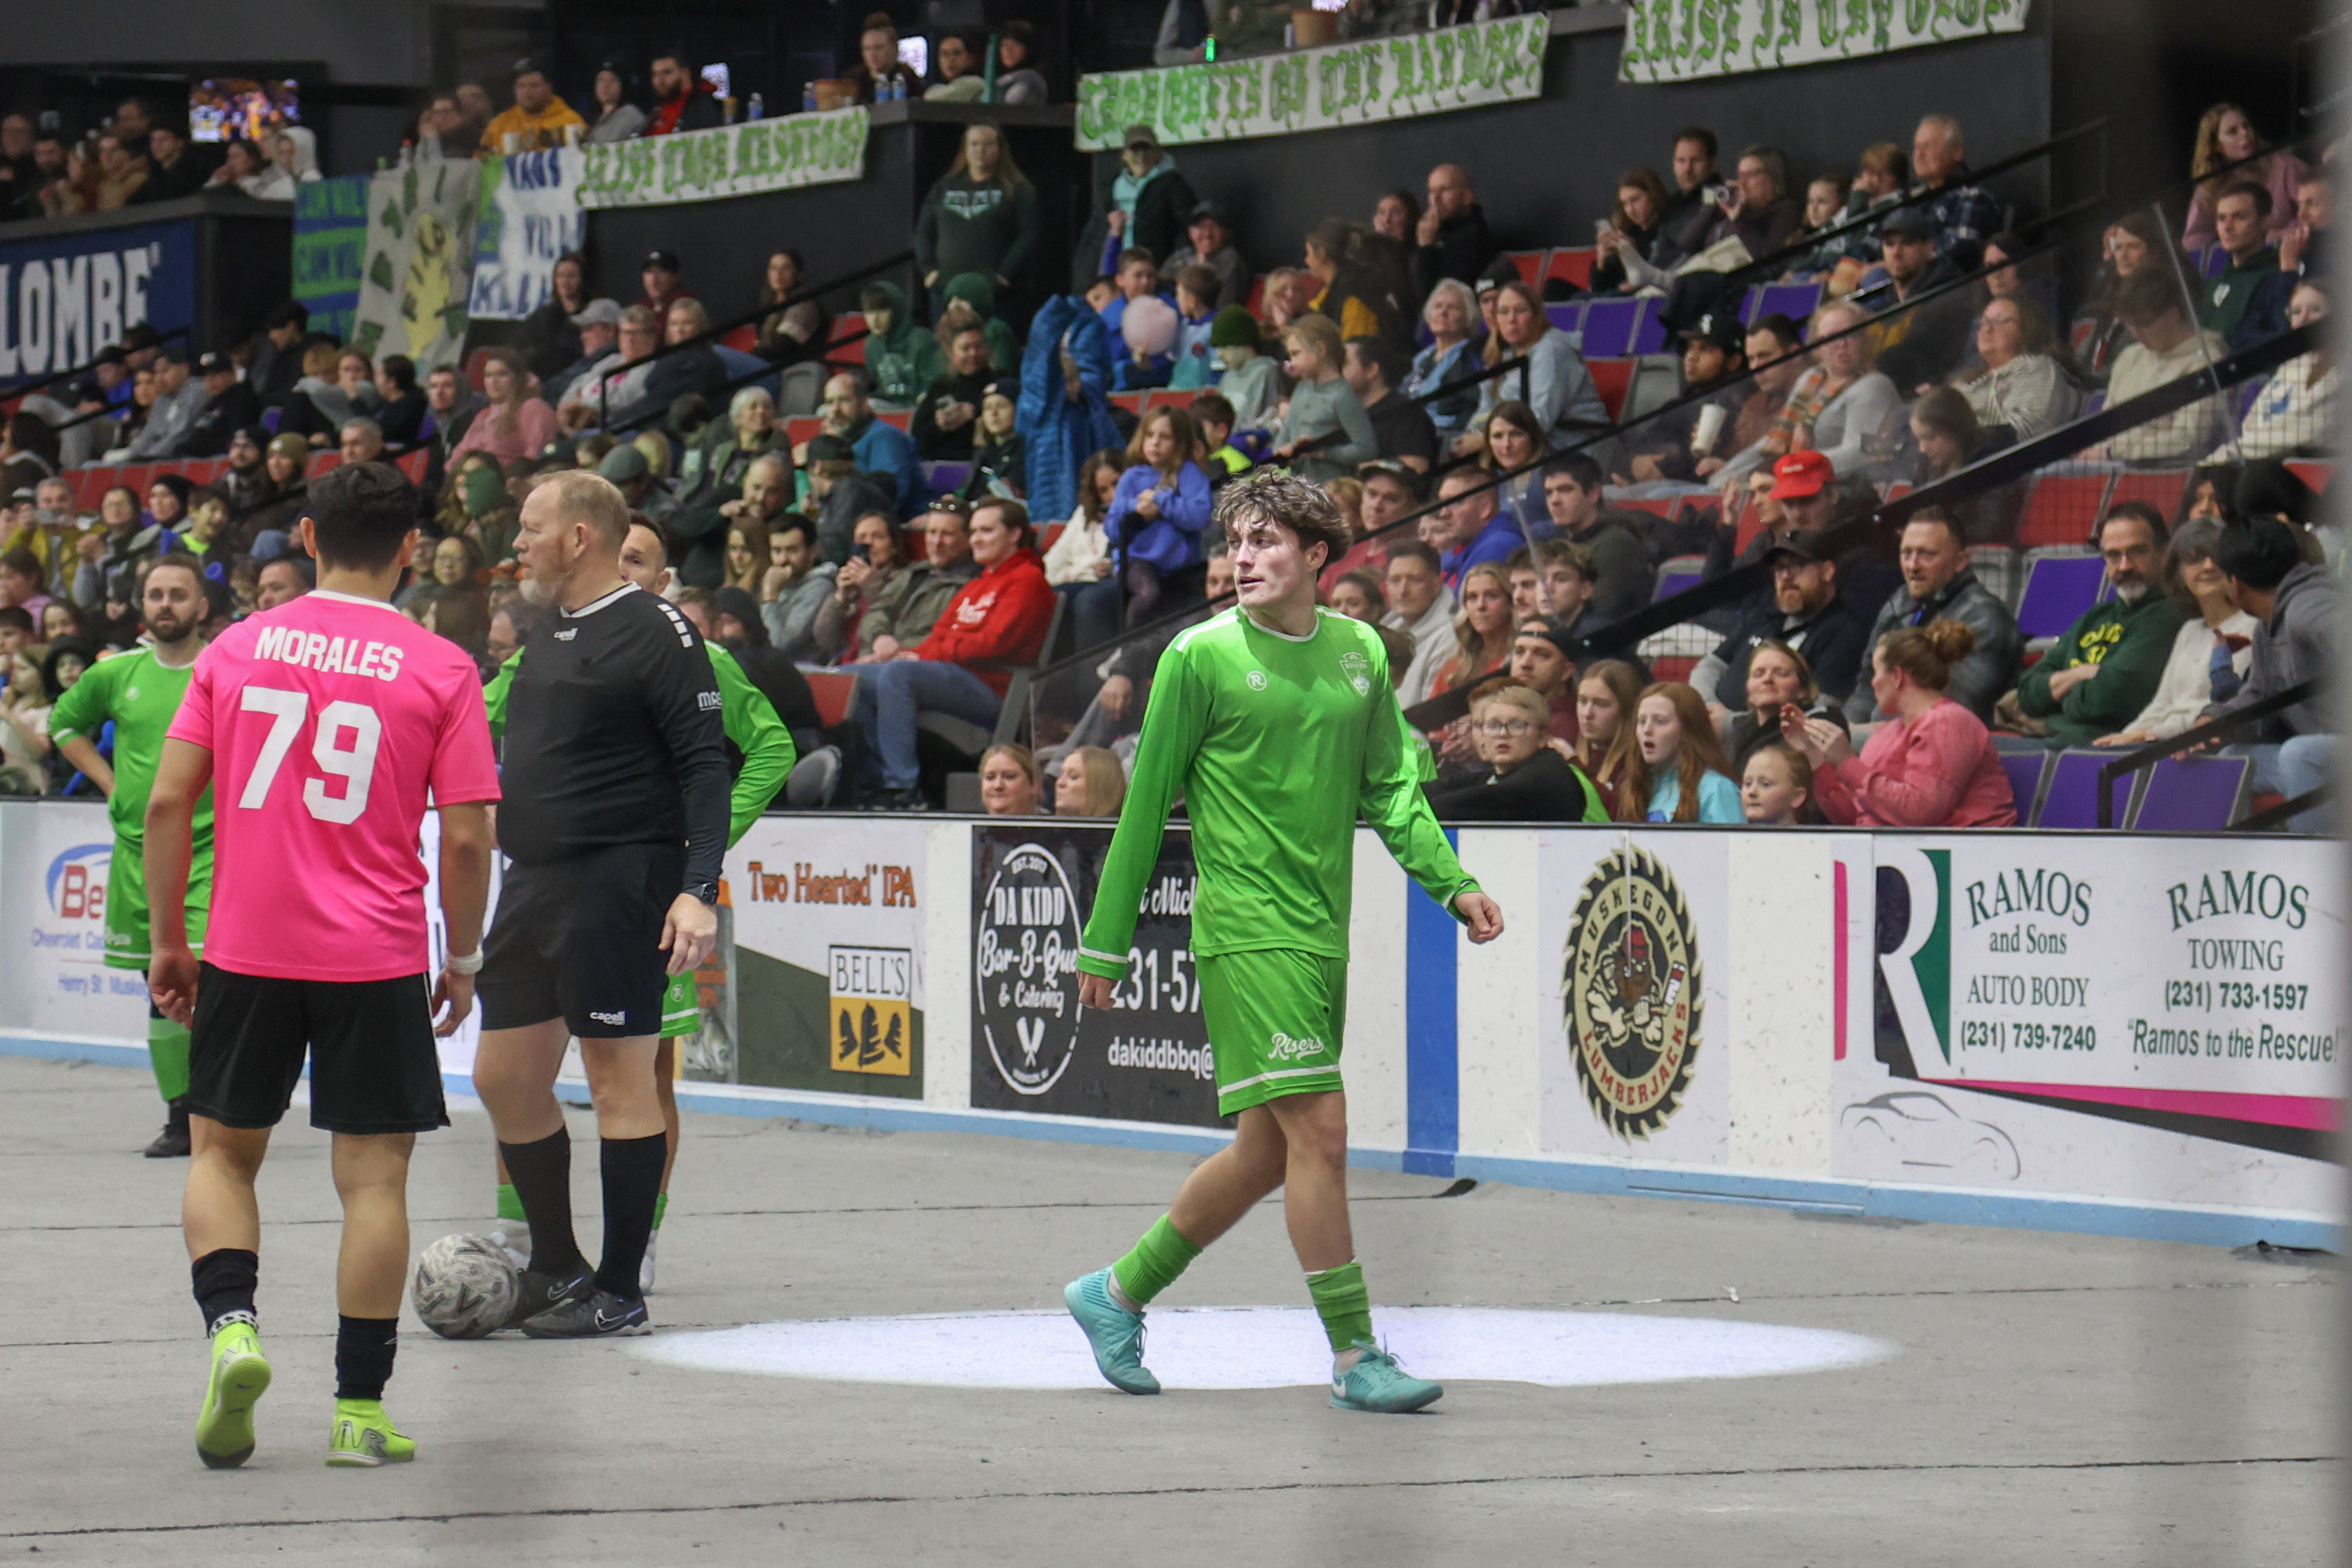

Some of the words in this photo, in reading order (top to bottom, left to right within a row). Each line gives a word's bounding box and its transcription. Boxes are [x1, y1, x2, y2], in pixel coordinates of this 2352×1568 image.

[253, 626, 404, 682] MORALES
[239, 686, 382, 825] 79
[748, 861, 789, 903] Two
[794, 863, 872, 905] Hearted
[883, 865, 917, 908] IPA
[1967, 868, 2093, 927] RAMOS
[2166, 870, 2310, 932] RAMOS
[994, 886, 1017, 926] DA
[1021, 886, 1067, 926] KIDD
[1580, 883, 1681, 975] MUSKEGON
[1989, 926, 2021, 952] and
[2026, 924, 2068, 955] Sons
[2188, 937, 2286, 972] TOWING
[835, 954, 906, 997] BELL'S
[1967, 975, 2025, 1006] AUTO
[2031, 977, 2090, 1008] BODY
[2164, 980, 2213, 1010] (231)
[2219, 982, 2310, 1012] 733-1597
[998, 982, 1011, 1008] &
[1015, 979, 1064, 1019] Catering
[1268, 1032, 1324, 1061] Risers
[1582, 1002, 1688, 1107] LUMBERJACKS
[1961, 1021, 2006, 1053] (231)
[2012, 1022, 2097, 1052] 739-7240
[2206, 1030, 2222, 1057] to
[2228, 1028, 2253, 1059] the
[1107, 1037, 1215, 1080] dakiddbbq@
